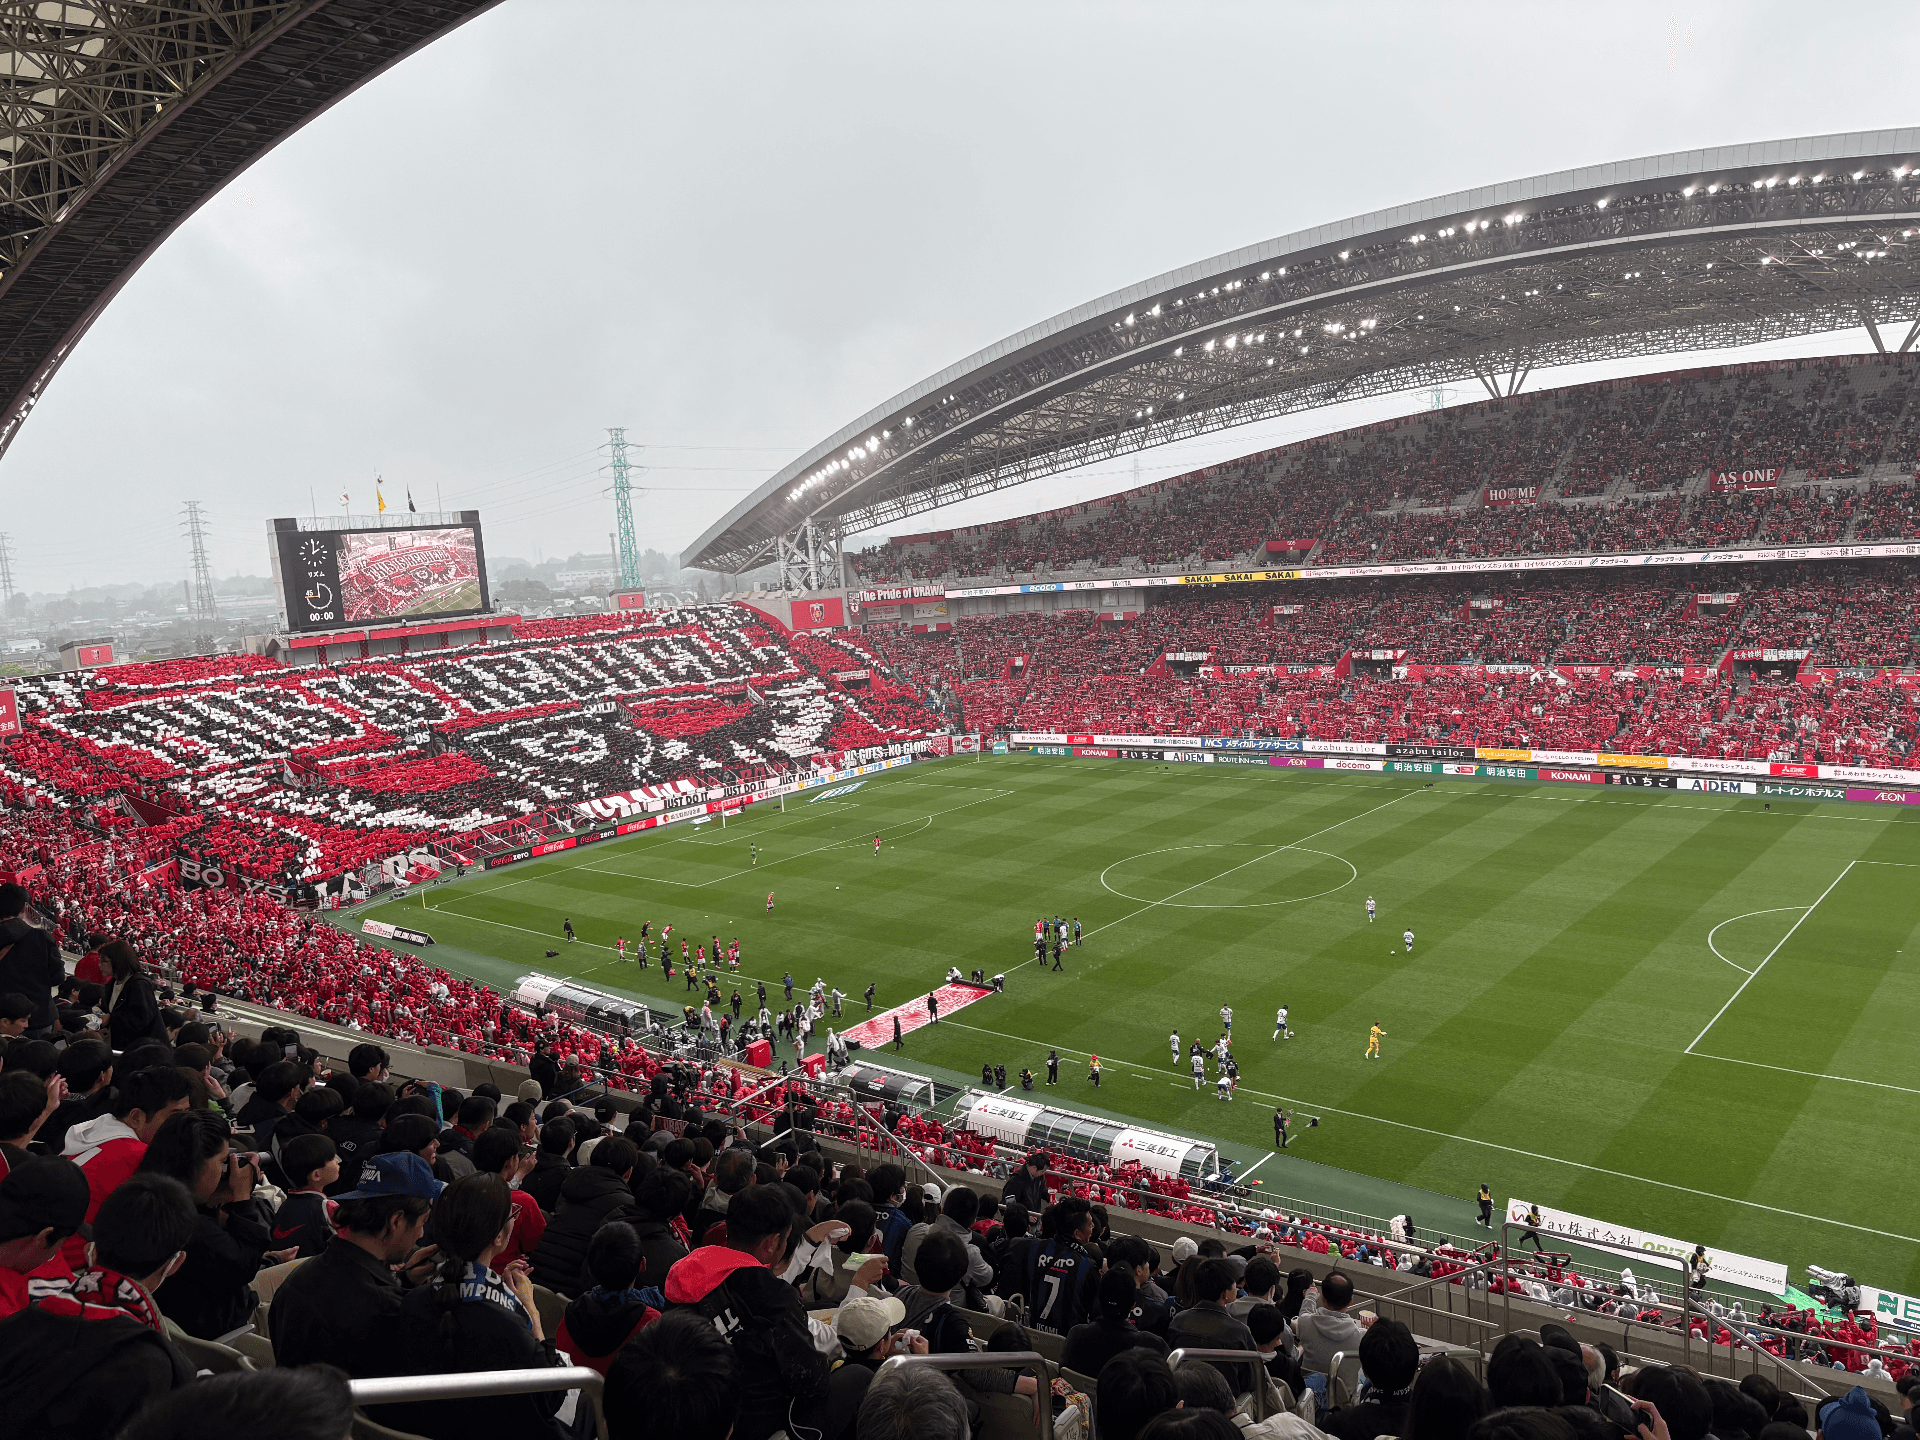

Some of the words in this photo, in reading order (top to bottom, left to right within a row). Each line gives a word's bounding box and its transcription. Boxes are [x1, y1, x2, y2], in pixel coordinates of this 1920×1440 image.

[1717, 471, 1737, 485] AS
[1743, 468, 1776, 482] ONE
[308, 570, 325, 578] リズム
[1184, 575, 1212, 584] SAKAI
[1224, 573, 1253, 581] SAKAI
[1265, 571, 1294, 579] SAKAI
[305, 589, 314, 597] 45
[860, 590, 876, 602] The
[877, 588, 901, 600] Pride
[903, 586, 912, 599] of
[914, 584, 945, 598] URAWA
[309, 611, 334, 622] 00:00
[1204, 740, 1223, 748] MCS
[1311, 744, 1341, 752] azabu
[1344, 744, 1376, 753] tailor
[888, 743, 902, 757] NO
[1038, 746, 1065, 756] 明治安田
[1081, 749, 1109, 757] KONAMI
[1130, 751, 1161, 760] いちご
[1395, 747, 1428, 755] azabu
[1431, 747, 1465, 757] tailor
[1218, 756, 1238, 764] ROUTE
[1394, 762, 1432, 773] 明治安田
[1486, 767, 1526, 778] 明治安田
[779, 773, 797, 785] JUST
[798, 771, 811, 781] DO
[1551, 771, 1591, 782] KONAMI
[1625, 776, 1670, 788] いちご
[724, 785, 741, 798] JUST
[744, 782, 757, 793] DO
[1805, 788, 1845, 799] ホテルズ
[664, 795, 685, 809] JUST
[686, 793, 699, 804] DO
[600, 829, 615, 839] zero
[513, 851, 529, 861] zero
[989, 1105, 1028, 1122] 三菱重工
[1135, 1141, 1181, 1159] 三菱重工
[1040, 1274, 1061, 1320] 7
